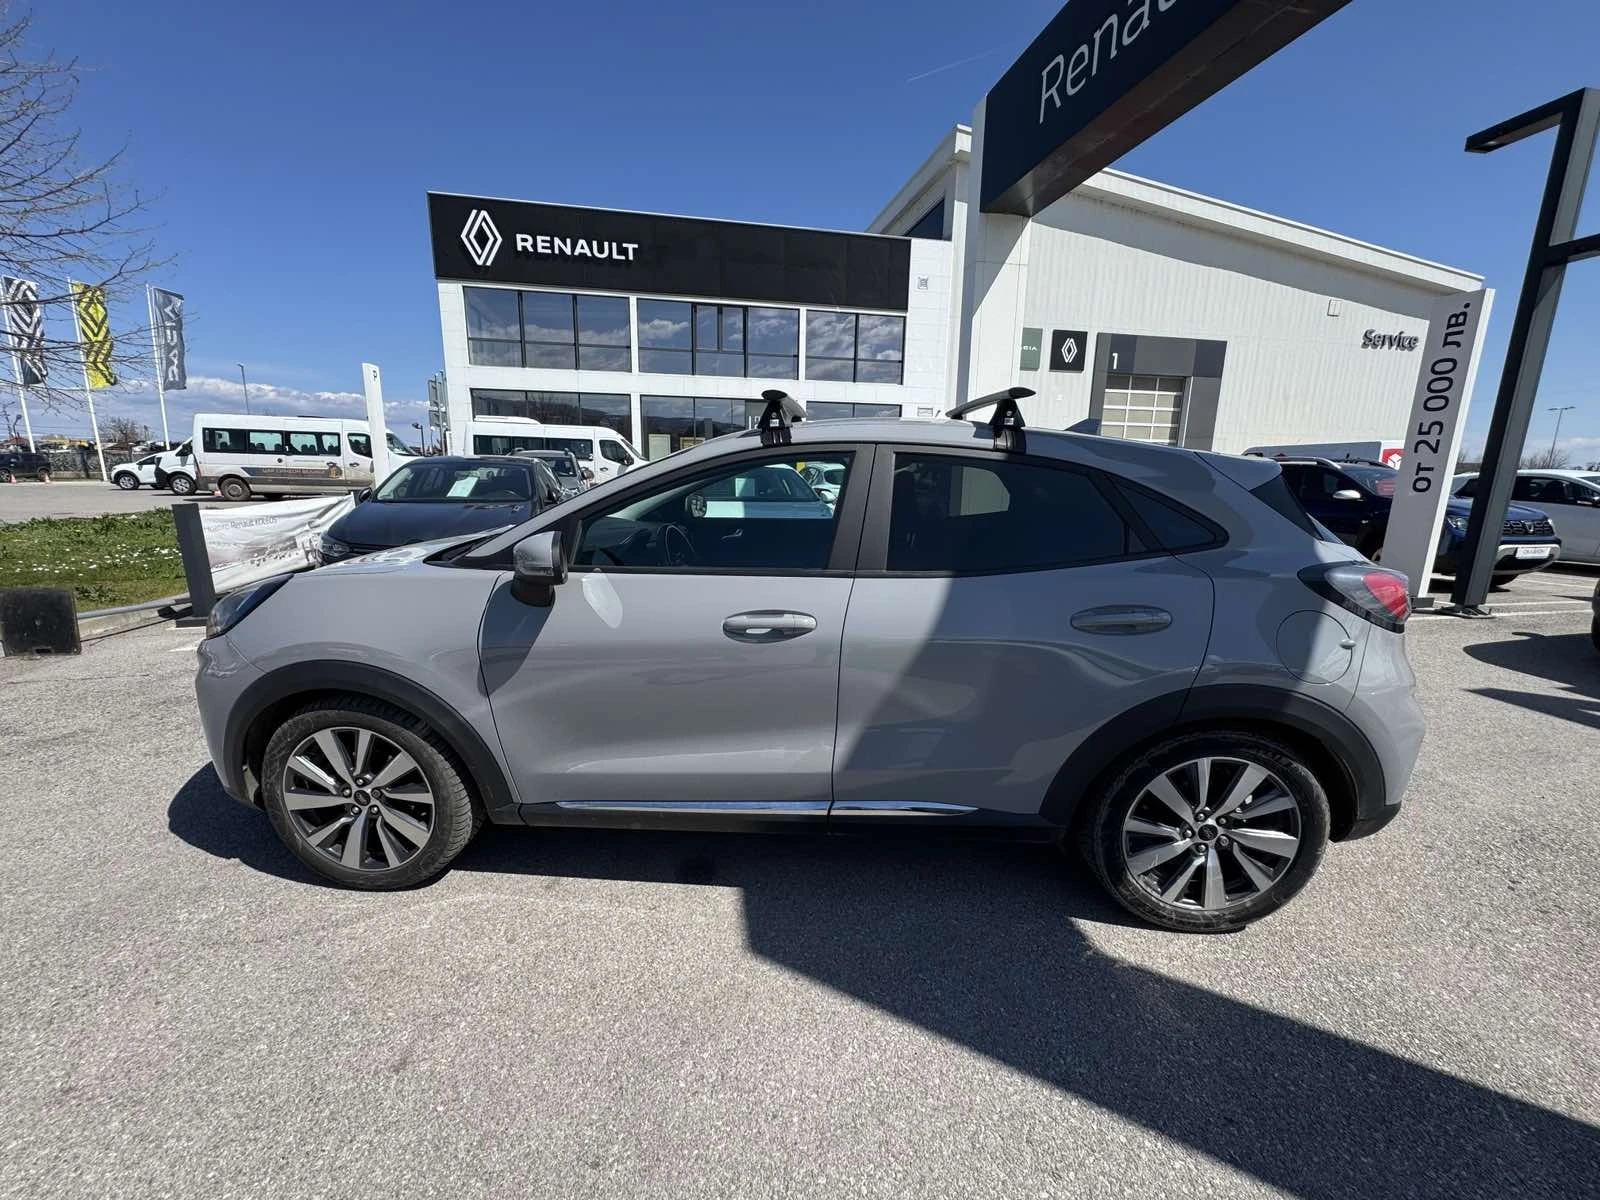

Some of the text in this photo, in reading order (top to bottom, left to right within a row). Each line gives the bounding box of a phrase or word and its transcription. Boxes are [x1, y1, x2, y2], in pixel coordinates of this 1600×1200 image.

[1040, 0, 1177, 124] Rena
[515, 233, 639, 261] RENAULT
[1362, 329, 1419, 350] Service
[1112, 353, 1118, 369] 1
[1412, 302, 1471, 493] от 25 000 лв.
